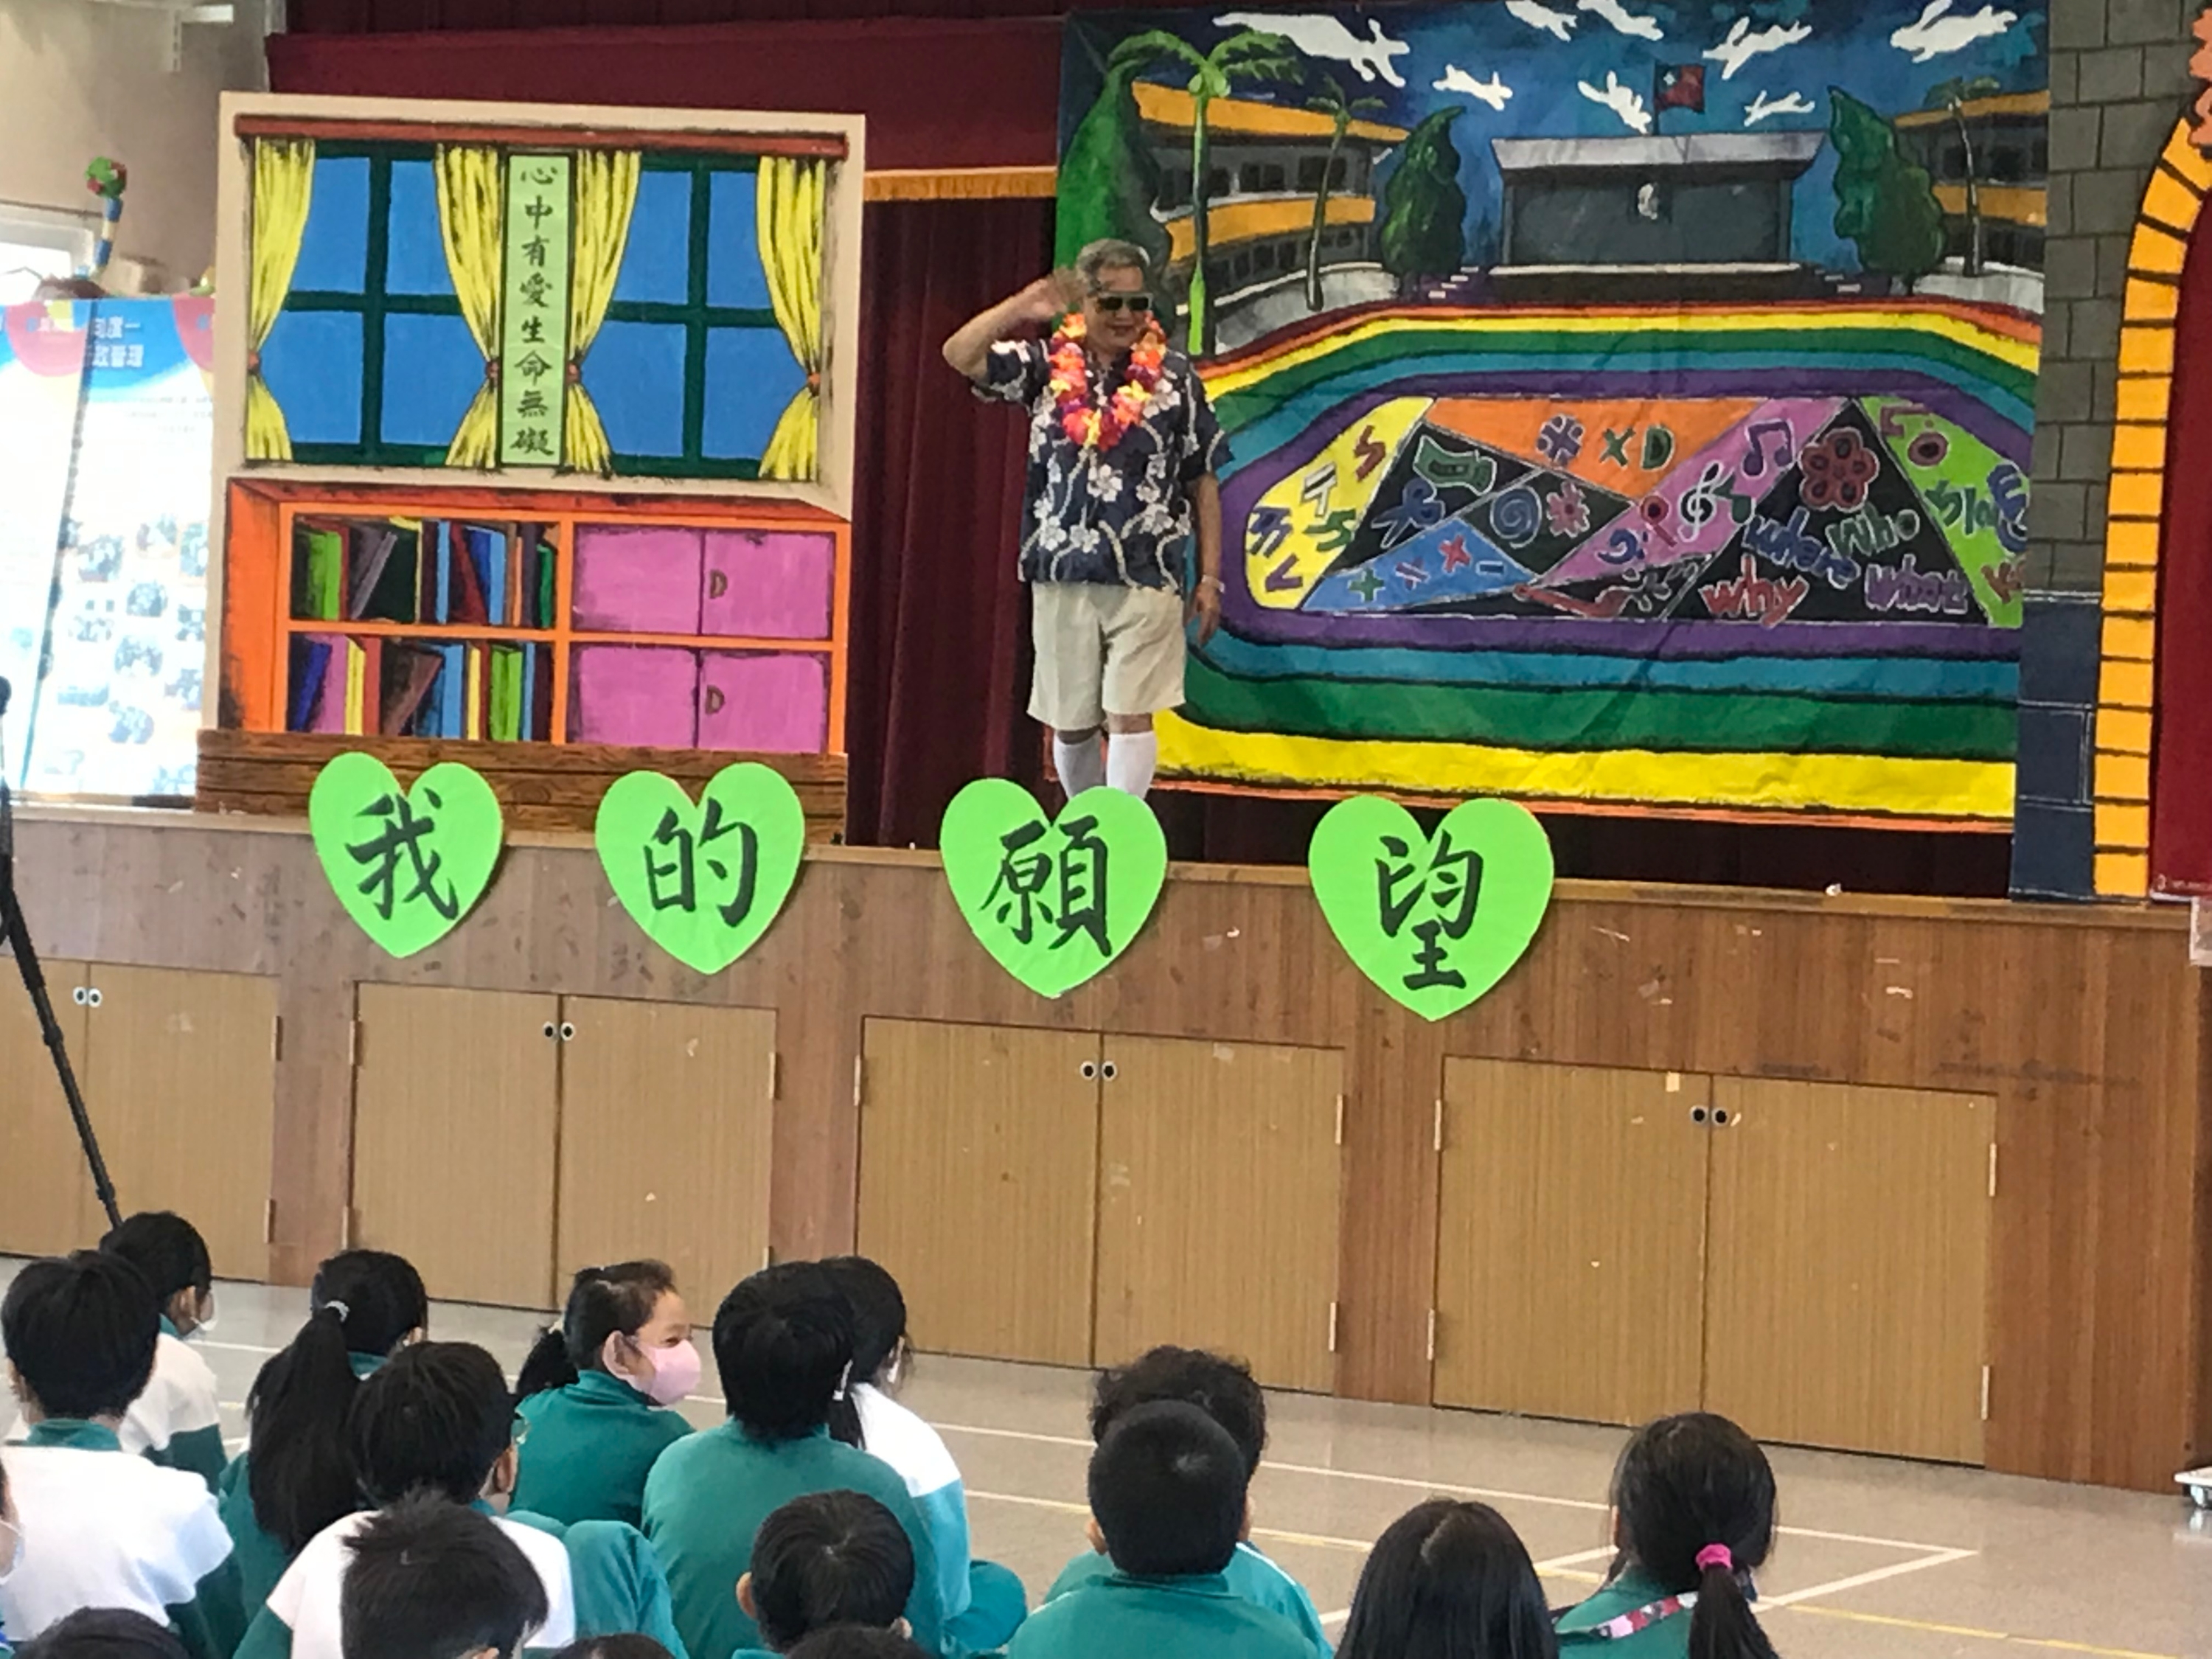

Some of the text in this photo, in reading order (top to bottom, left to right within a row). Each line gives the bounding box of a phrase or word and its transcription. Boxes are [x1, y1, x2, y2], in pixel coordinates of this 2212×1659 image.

[509, 166, 558, 457] 心中有愛生命無礙
[344, 787, 1484, 992] 我 的 願 望
